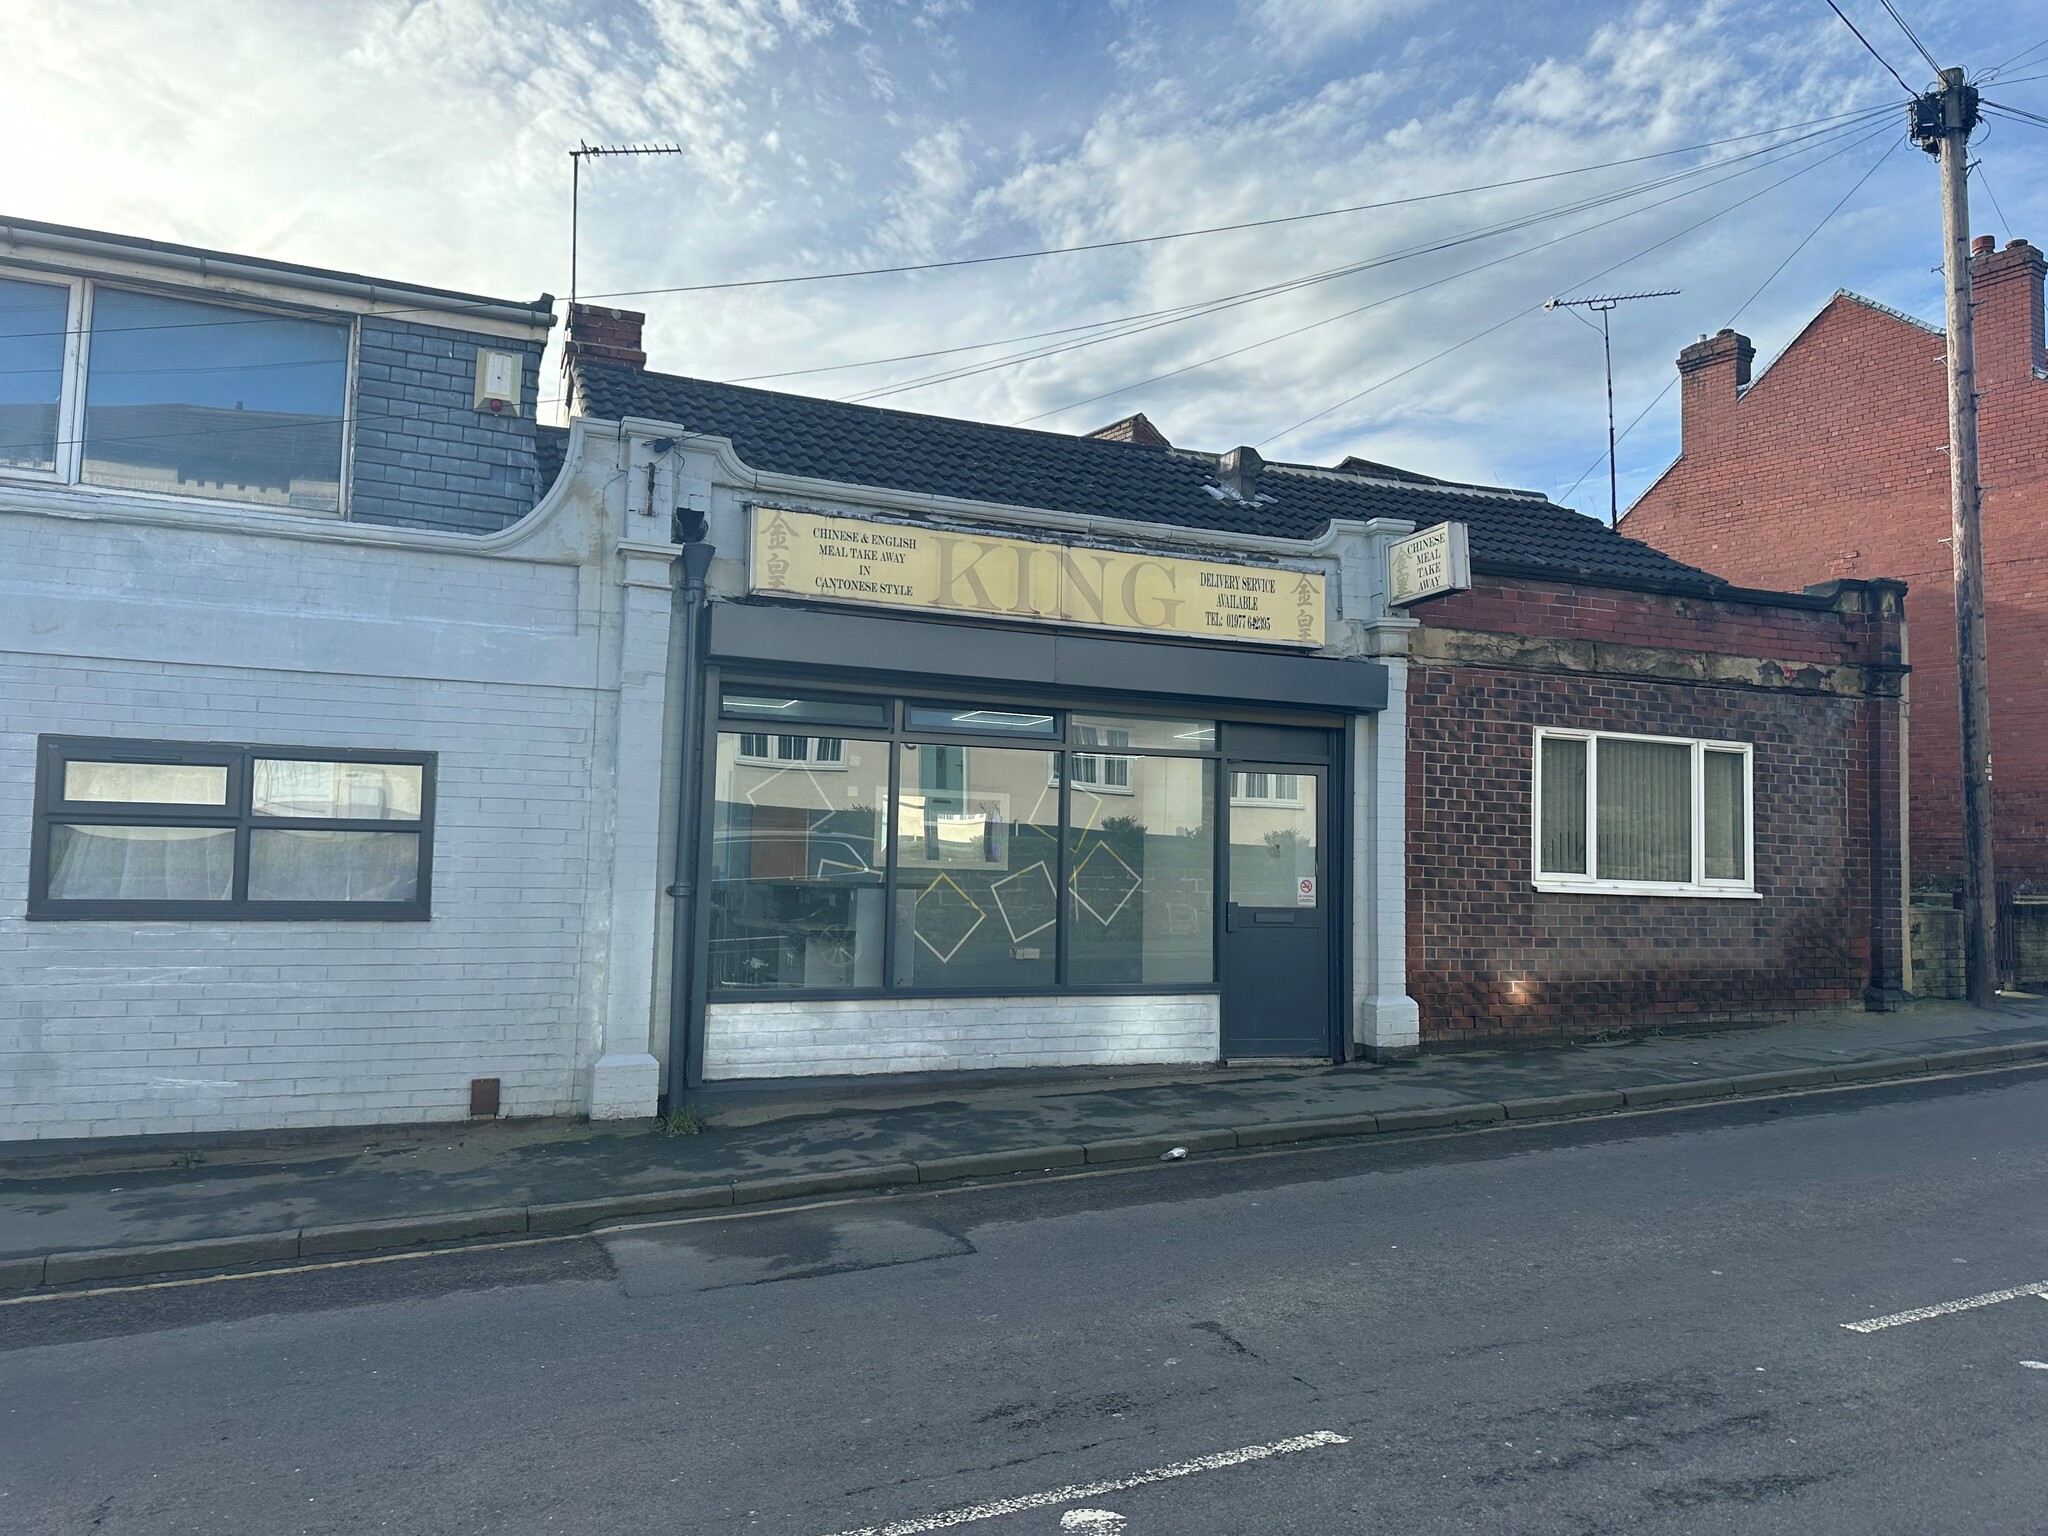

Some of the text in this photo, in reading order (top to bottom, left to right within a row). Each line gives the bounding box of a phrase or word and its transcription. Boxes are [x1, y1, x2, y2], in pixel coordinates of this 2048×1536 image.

[813, 528, 917, 549] CHINESE & ENGLISH
[1407, 533, 1446, 554] CHINESE
[819, 545, 906, 564] MEAL TAKE AWAY
[1416, 549, 1441, 565] MEAL
[859, 565, 871, 576] IN
[1416, 562, 1441, 578] TAKE
[815, 577, 913, 597] CANTONESE STYLE
[928, 536, 1186, 628] KING
[1200, 572, 1276, 593] DELIVERY SERVICE
[1418, 575, 1441, 592] AWAY
[1216, 594, 1258, 611] AVAILABLE
[1205, 611, 1223, 627] TEL:
[1226, 613, 1246, 629] 01977
